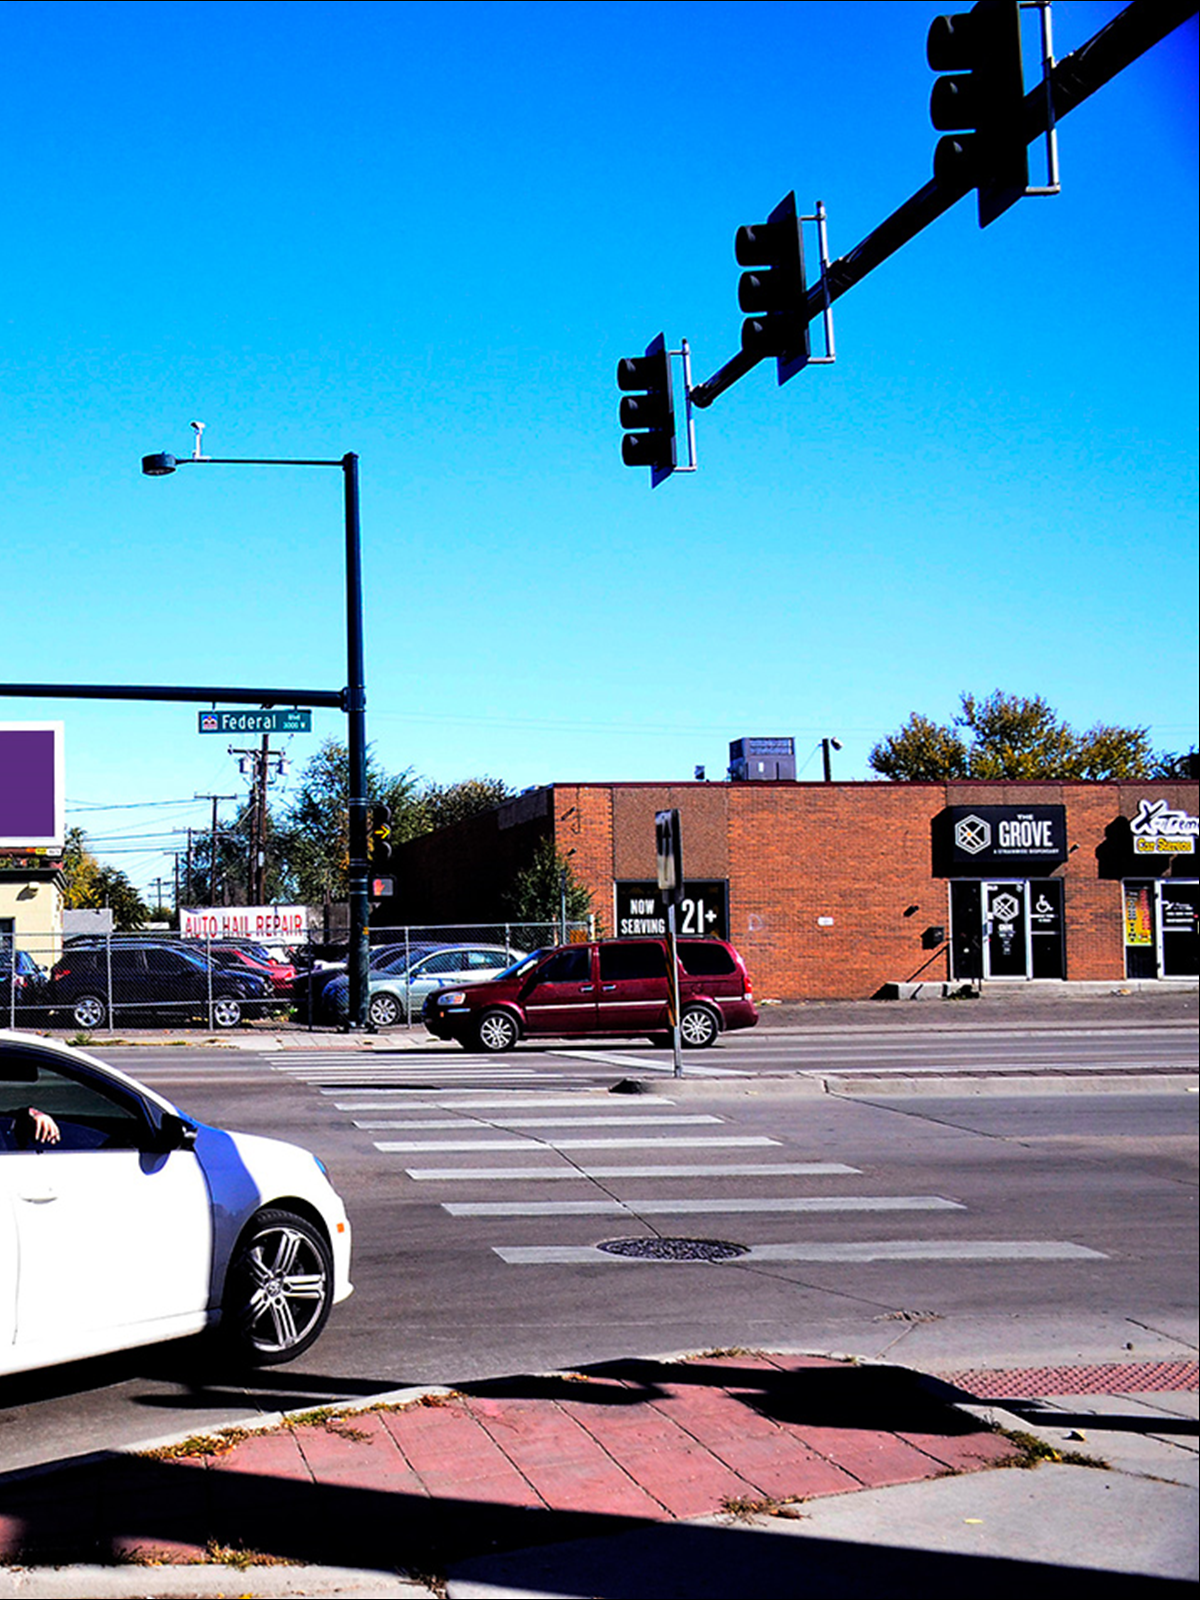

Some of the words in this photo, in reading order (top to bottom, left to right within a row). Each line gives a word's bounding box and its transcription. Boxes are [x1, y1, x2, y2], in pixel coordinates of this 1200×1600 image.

[221, 714, 277, 730] Federal
[998, 820, 1054, 848] GROVE
[1136, 837, 1155, 852] Car
[629, 898, 655, 915] NOW
[680, 898, 718, 934] 21+
[185, 915, 218, 939] AUTO
[222, 915, 252, 938] HAIL
[255, 914, 303, 937] REPAIR
[620, 918, 666, 935] SERVING
